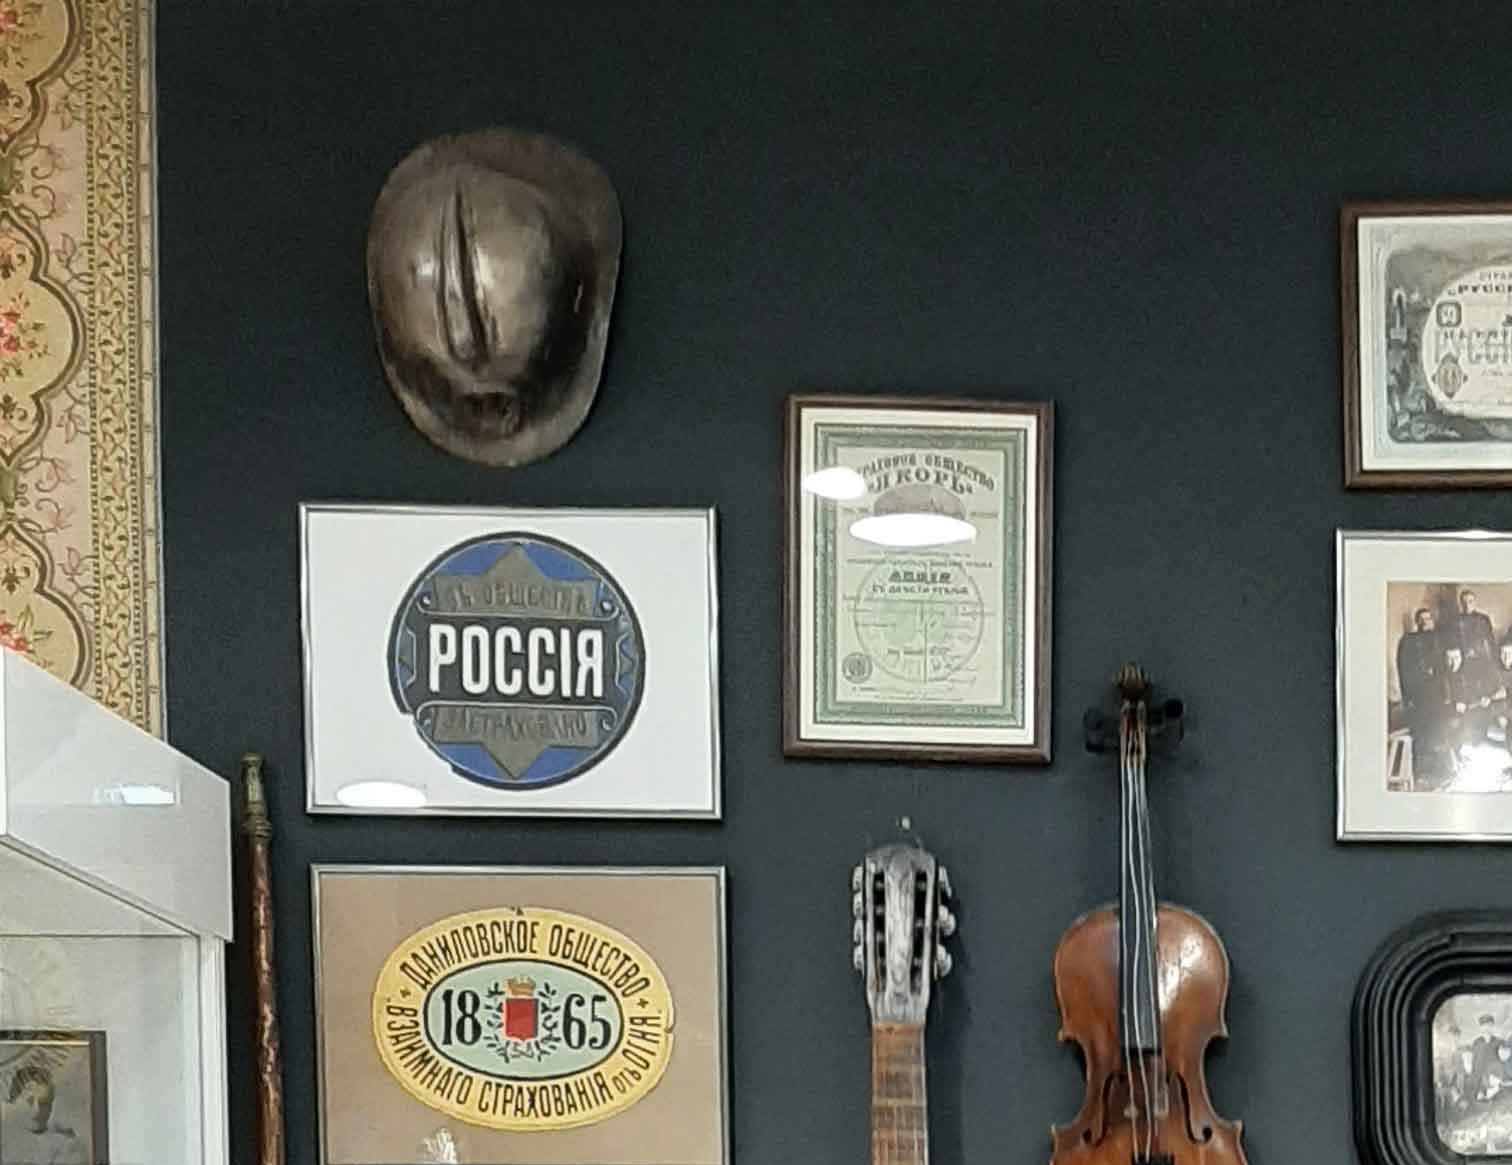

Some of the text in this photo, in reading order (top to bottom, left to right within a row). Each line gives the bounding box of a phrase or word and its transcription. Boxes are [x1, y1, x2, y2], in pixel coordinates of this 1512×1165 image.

[429, 623, 604, 698] РОССІЯ
[400, 920, 651, 998] ДАНИЛОВСКОЕ ОБЩЕСТВО
[441, 989, 612, 1050] 18 65
[386, 1001, 474, 1106] ВЗАИМНАГО
[477, 1072, 614, 1119] СТРАХОВАНІЯ
[622, 1015, 661, 1072] ОГНЯ
